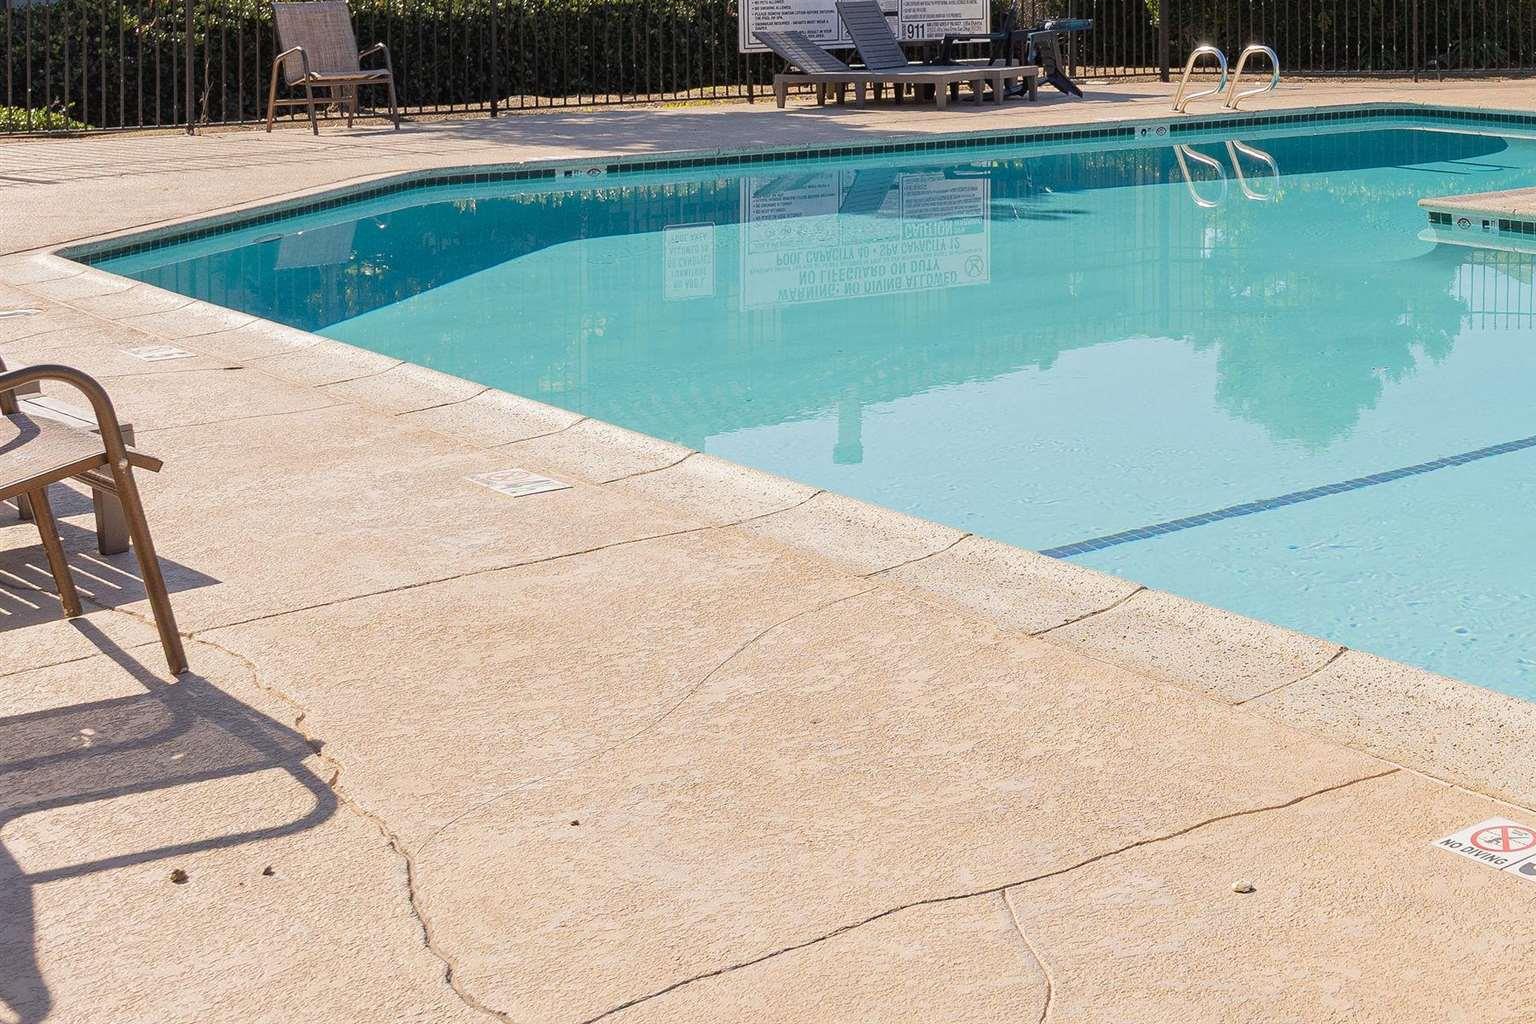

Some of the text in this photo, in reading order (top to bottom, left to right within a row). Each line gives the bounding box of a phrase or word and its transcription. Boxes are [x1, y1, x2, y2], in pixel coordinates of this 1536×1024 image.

[907, 24, 925, 39] 911
[1440, 838, 1509, 866] NO DIVING
